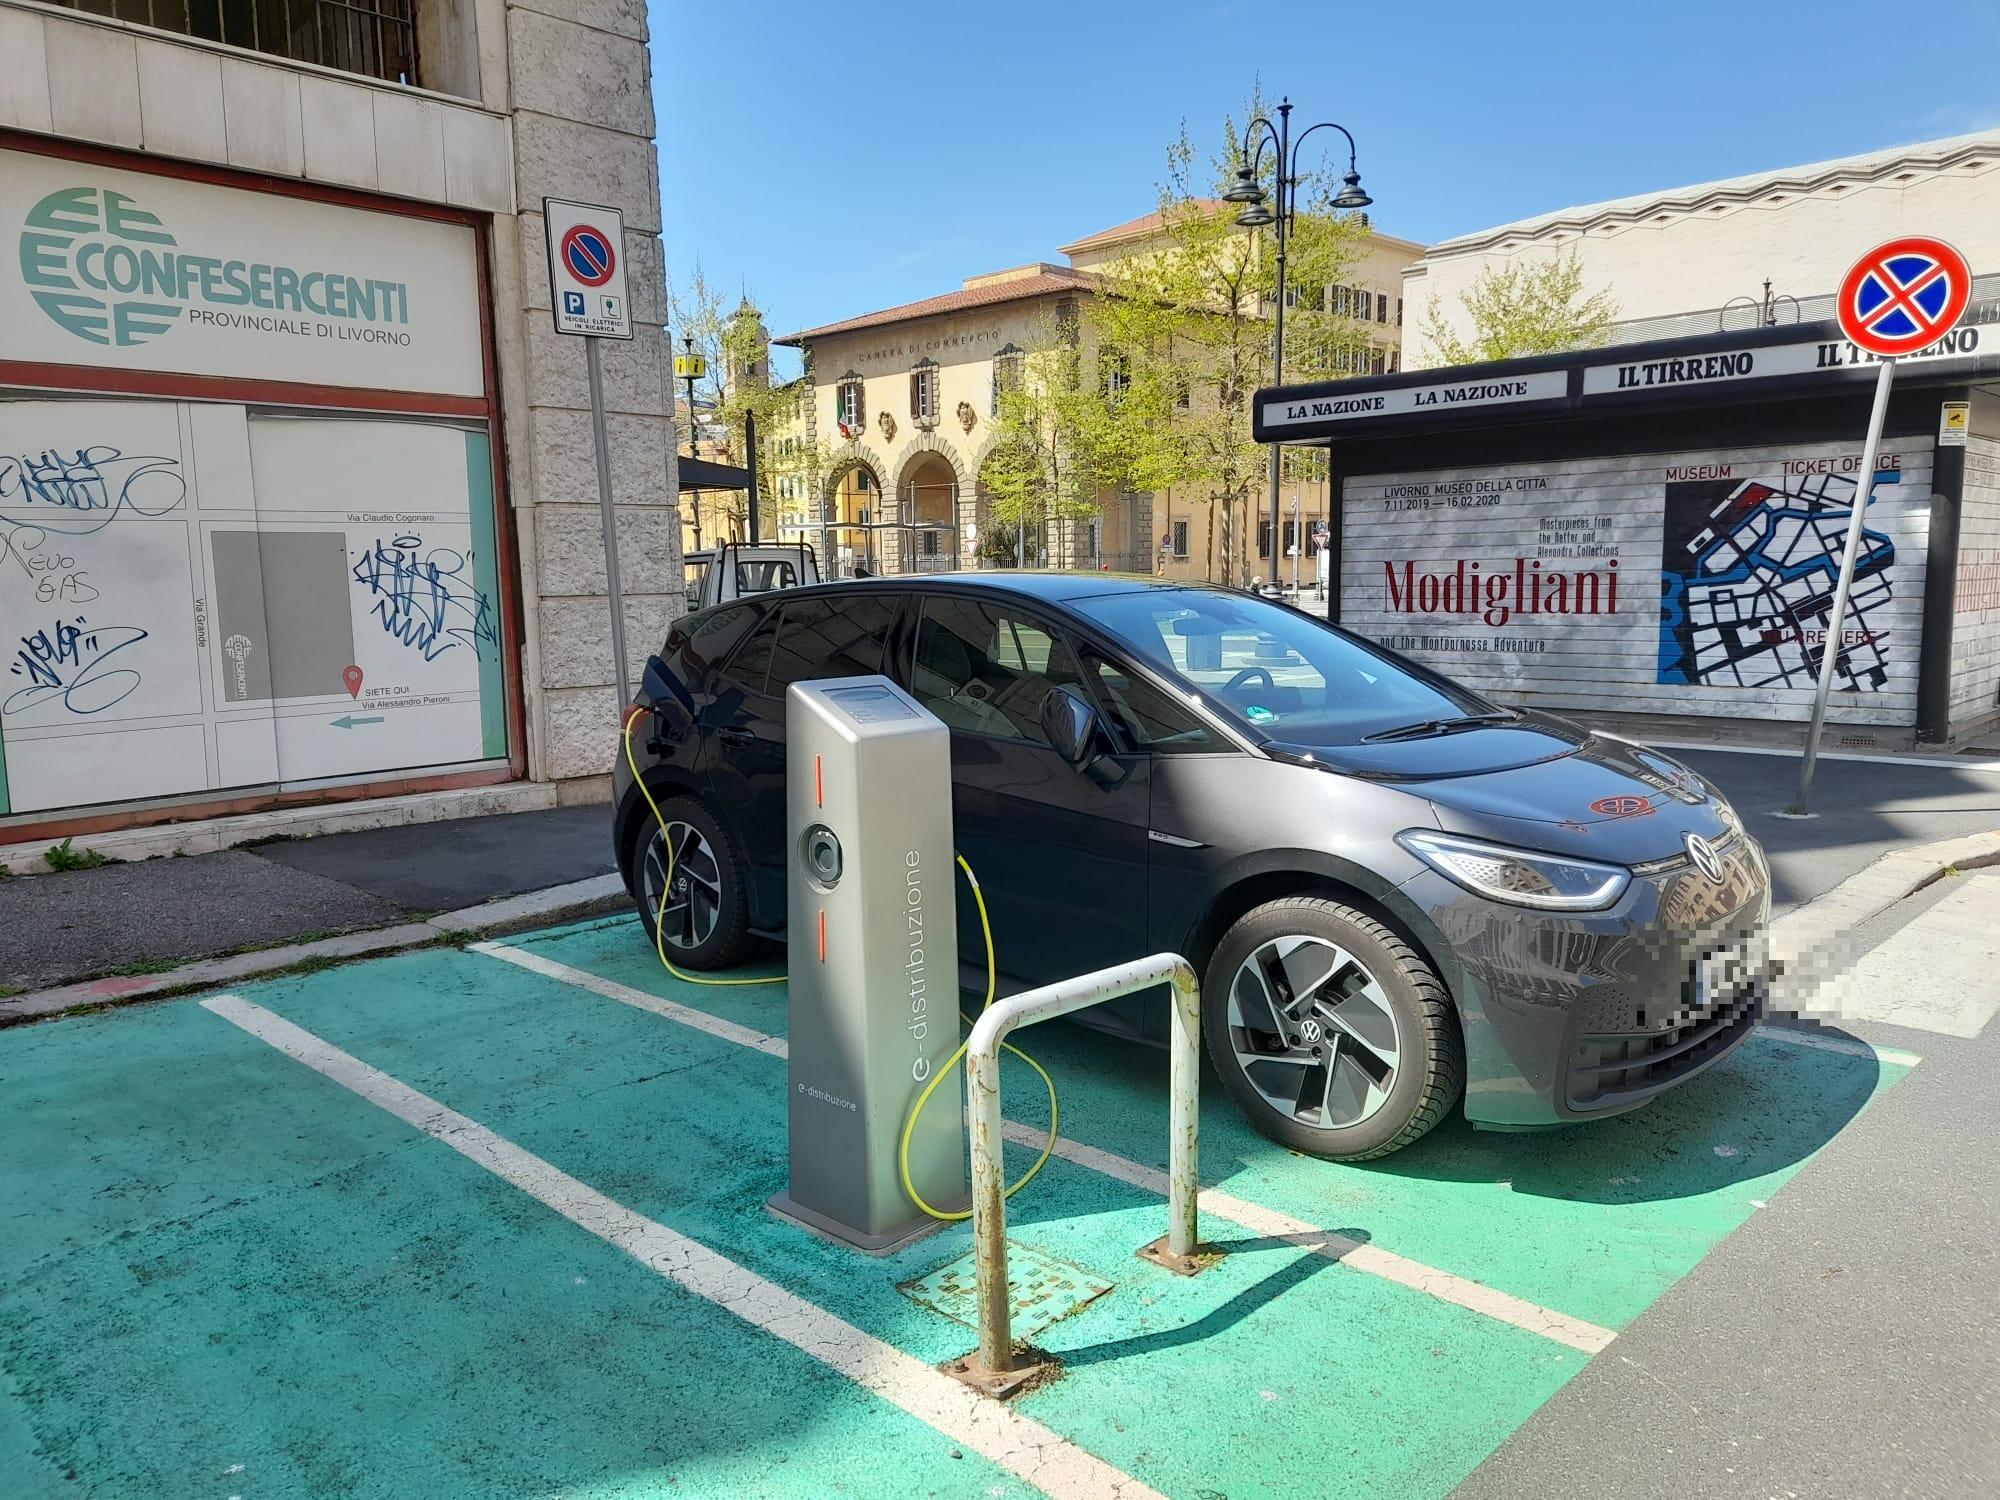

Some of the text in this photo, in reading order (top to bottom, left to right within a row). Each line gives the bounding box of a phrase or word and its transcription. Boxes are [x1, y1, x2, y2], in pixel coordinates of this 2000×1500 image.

[568, 294, 581, 313] P
[189, 309, 411, 347] PROVINCIALE DI LIVORNO
[564, 315, 624, 327] VEICOLI ELETTRICI
[858, 330, 999, 362] CAMERA DI COMMERCIO
[1817, 344, 1842, 368] IL
[1617, 352, 1754, 388] IL TIRRENO
[1414, 381, 1528, 407] LA NAZIONE
[1286, 396, 1385, 420] LA NAZIONE
[1665, 465, 1732, 480] MUSEUM
[1780, 454, 1902, 475] TICKET OFICE
[1434, 482, 1473, 496] MUSEO
[1476, 480, 1513, 493] DELLA
[1384, 498, 1429, 512] 7.11.2019
[1447, 494, 1500, 508] 16.02.2020
[347, 513, 360, 521] Via
[362, 513, 394, 522] Claudio
[1540, 516, 1612, 530] Masterpieces from
[1539, 532, 1551, 544] the
[1582, 531, 1596, 542] and
[1537, 544, 1619, 558] Alexandre Collections
[1383, 557, 1618, 627] Modigliani
[194, 598, 207, 648] Via Grande
[1380, 636, 1545, 651] and the Montparnasse Adventure
[365, 686, 410, 697] SIETE QUI
[361, 695, 450, 710] Via Alessandro Pieroni
[903, 849, 930, 1082] e-distribuzione
[797, 1082, 857, 1112] e-distribuzione
